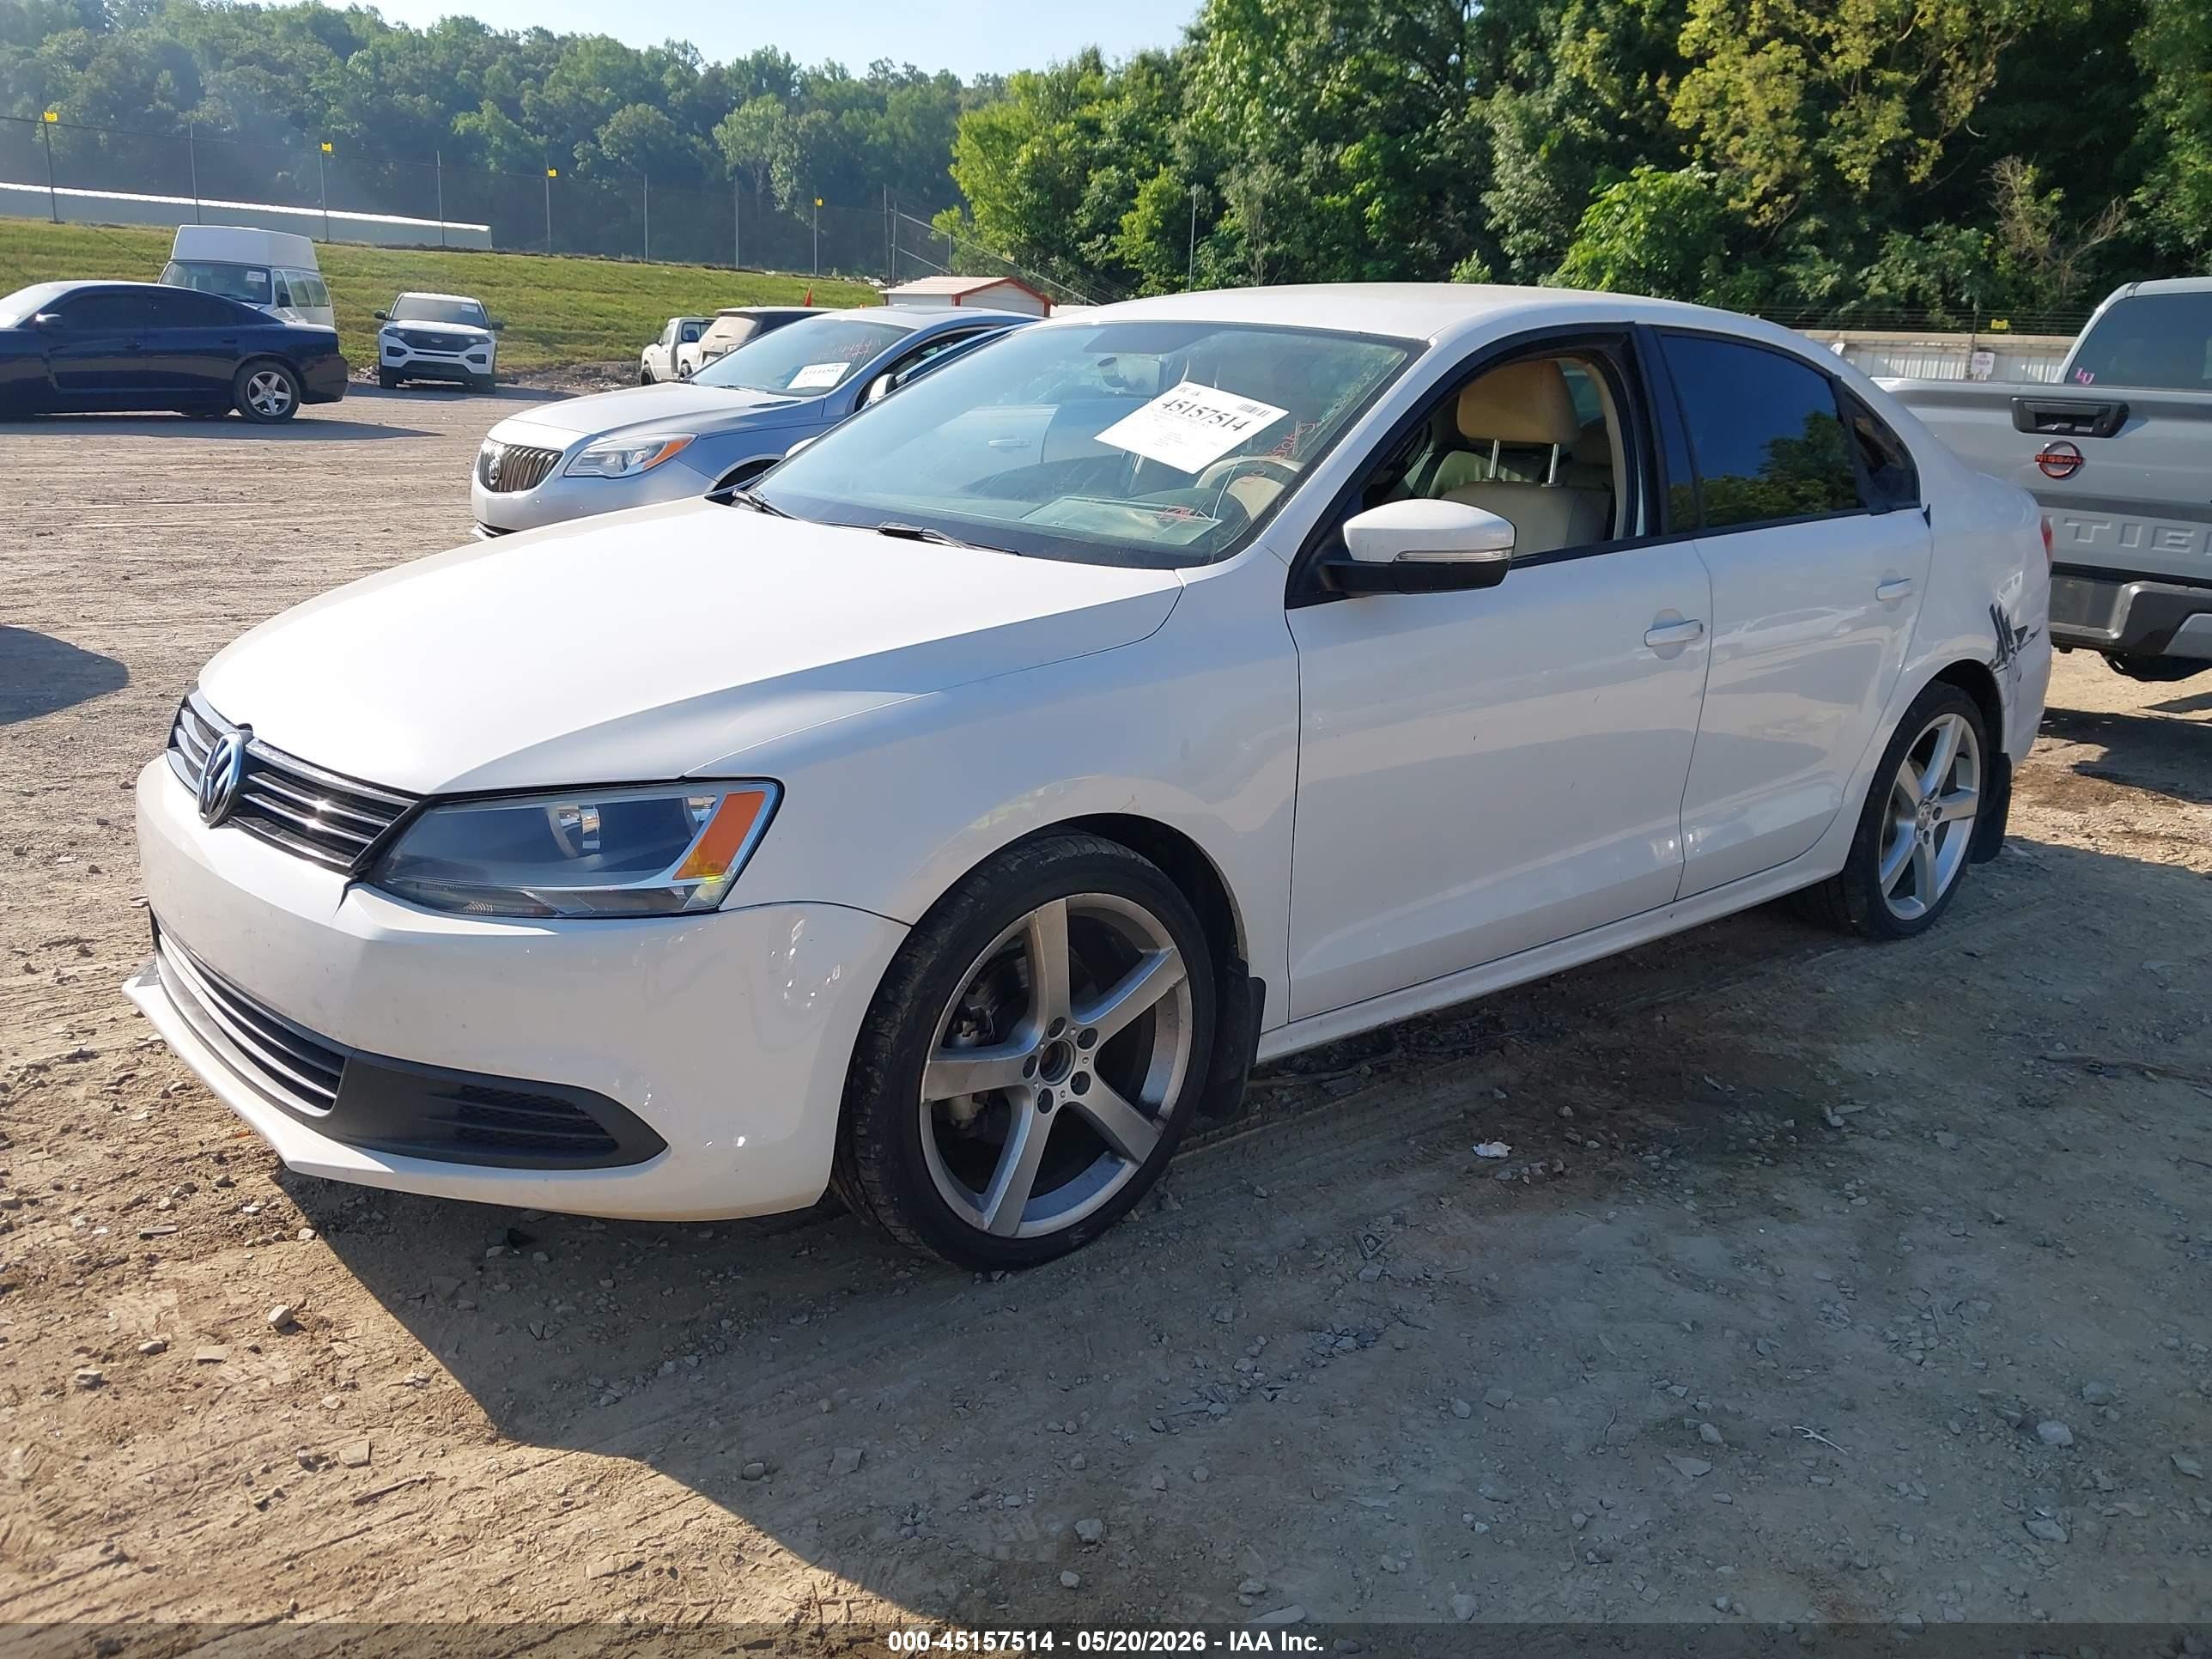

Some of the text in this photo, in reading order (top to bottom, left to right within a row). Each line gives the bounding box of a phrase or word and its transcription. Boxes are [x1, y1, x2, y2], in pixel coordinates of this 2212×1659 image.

[1161, 398, 1252, 432] 45157514
[2036, 454, 2082, 465] NISSAN
[2049, 517, 2212, 556] TIE
